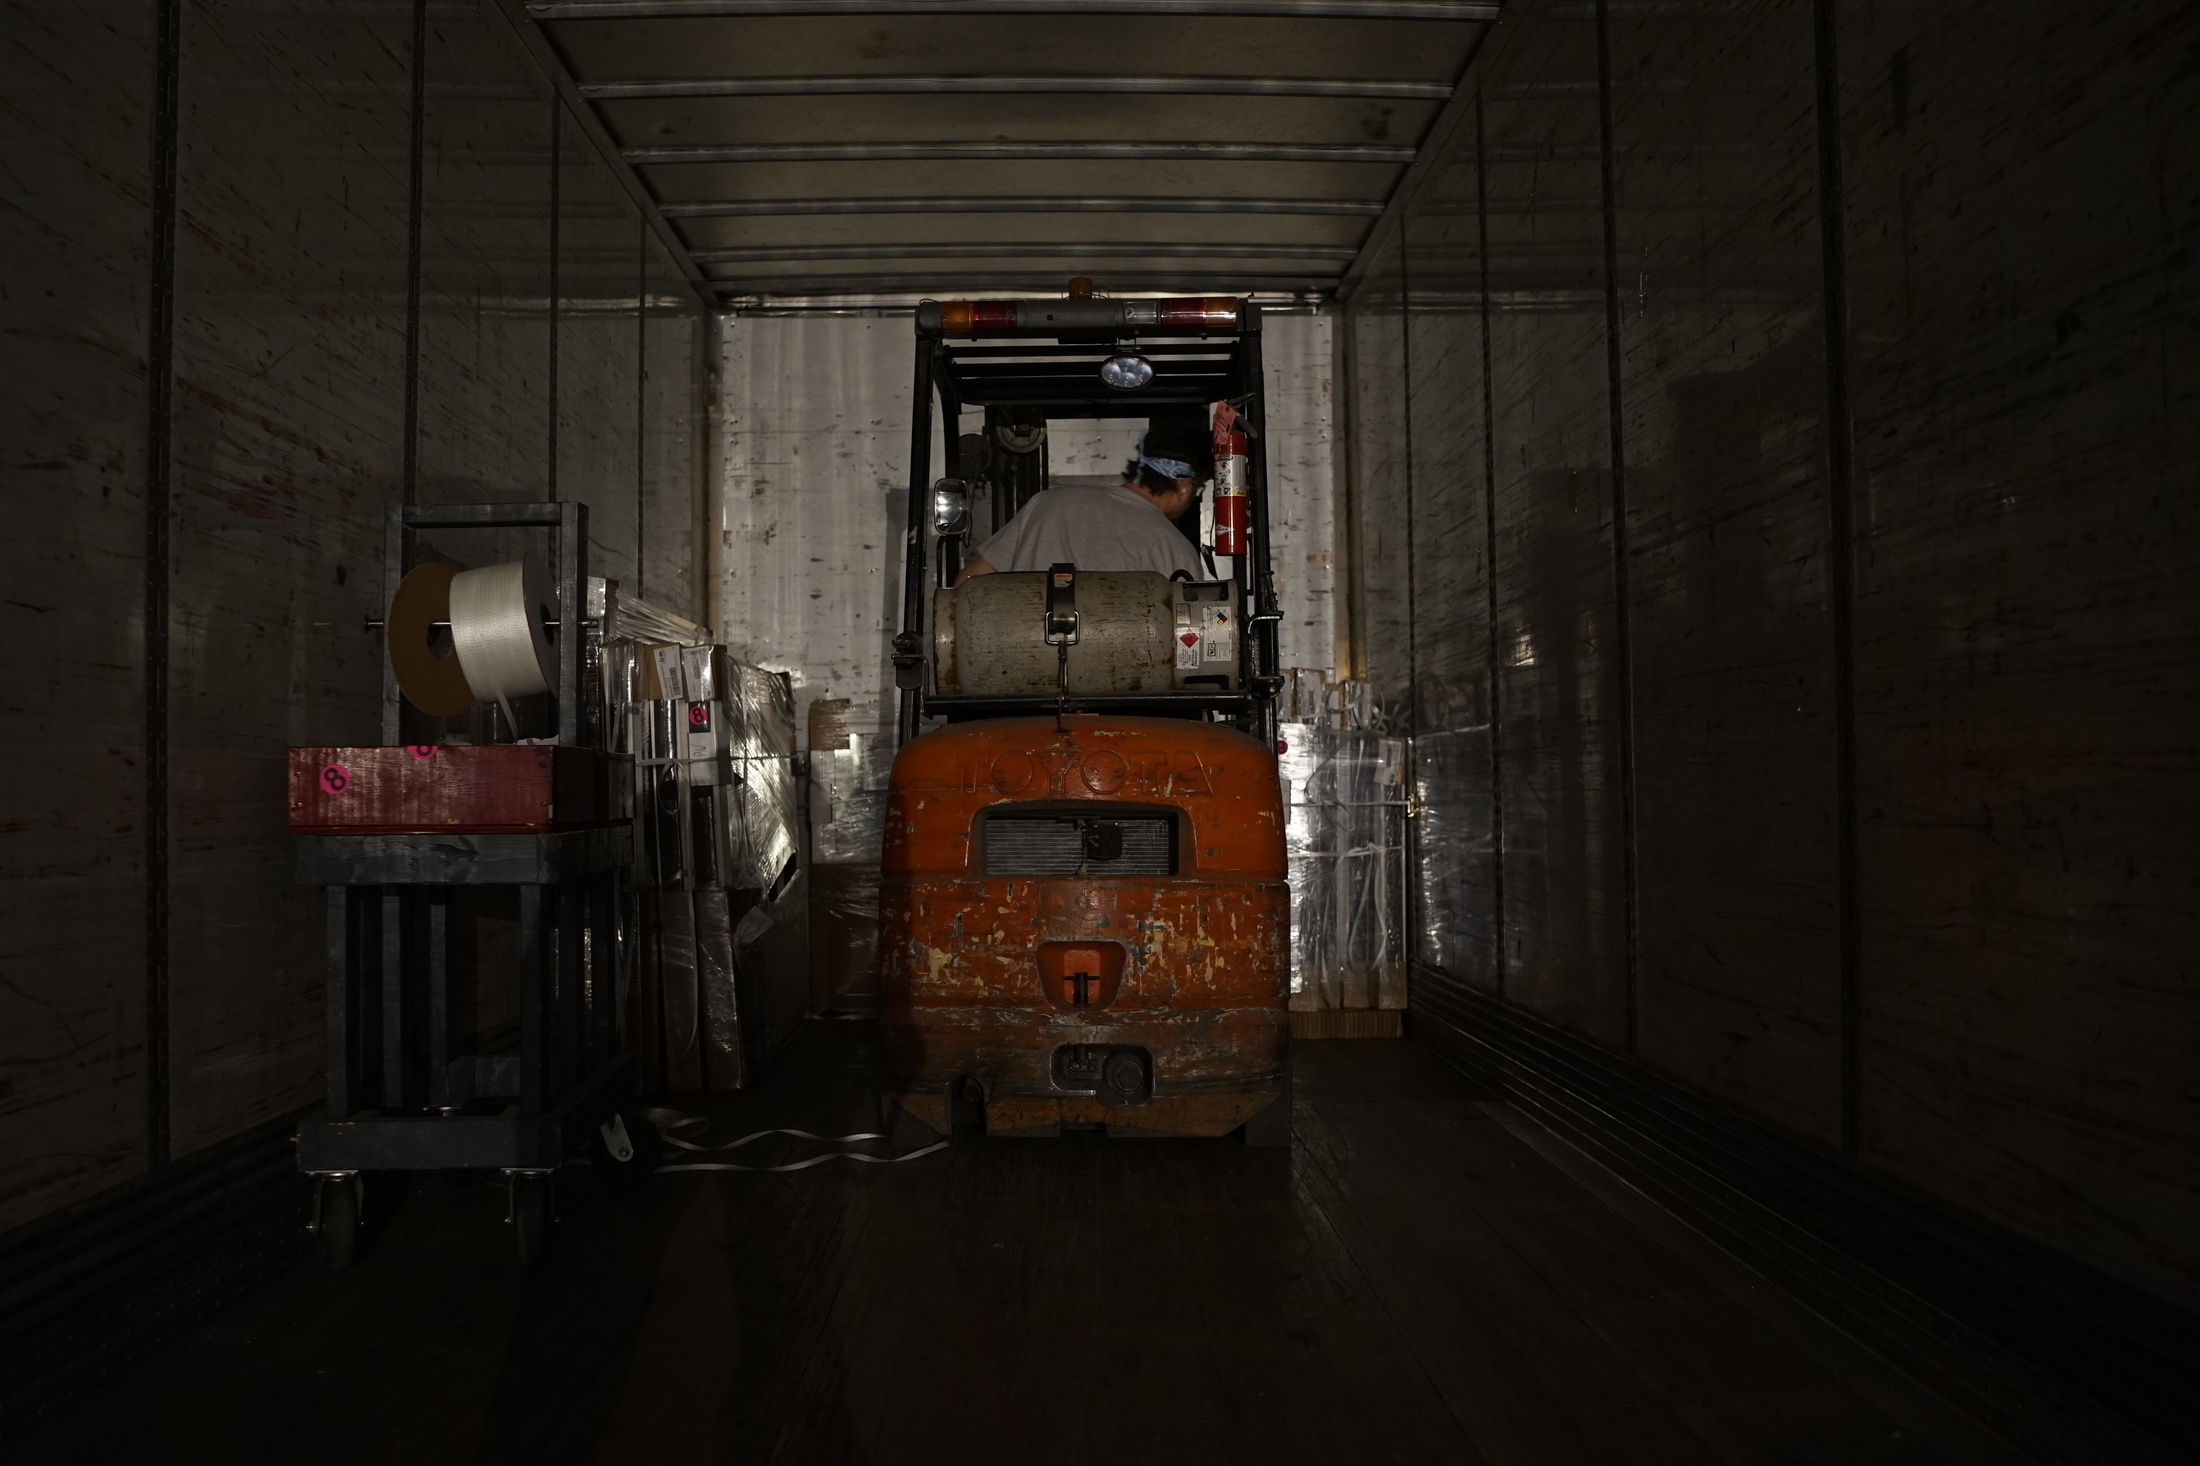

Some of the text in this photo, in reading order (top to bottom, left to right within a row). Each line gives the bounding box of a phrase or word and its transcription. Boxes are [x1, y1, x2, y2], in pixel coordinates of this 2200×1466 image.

[692, 708, 704, 723] 8
[324, 767, 346, 791] 8
[953, 749, 1214, 795] TOYOTA
